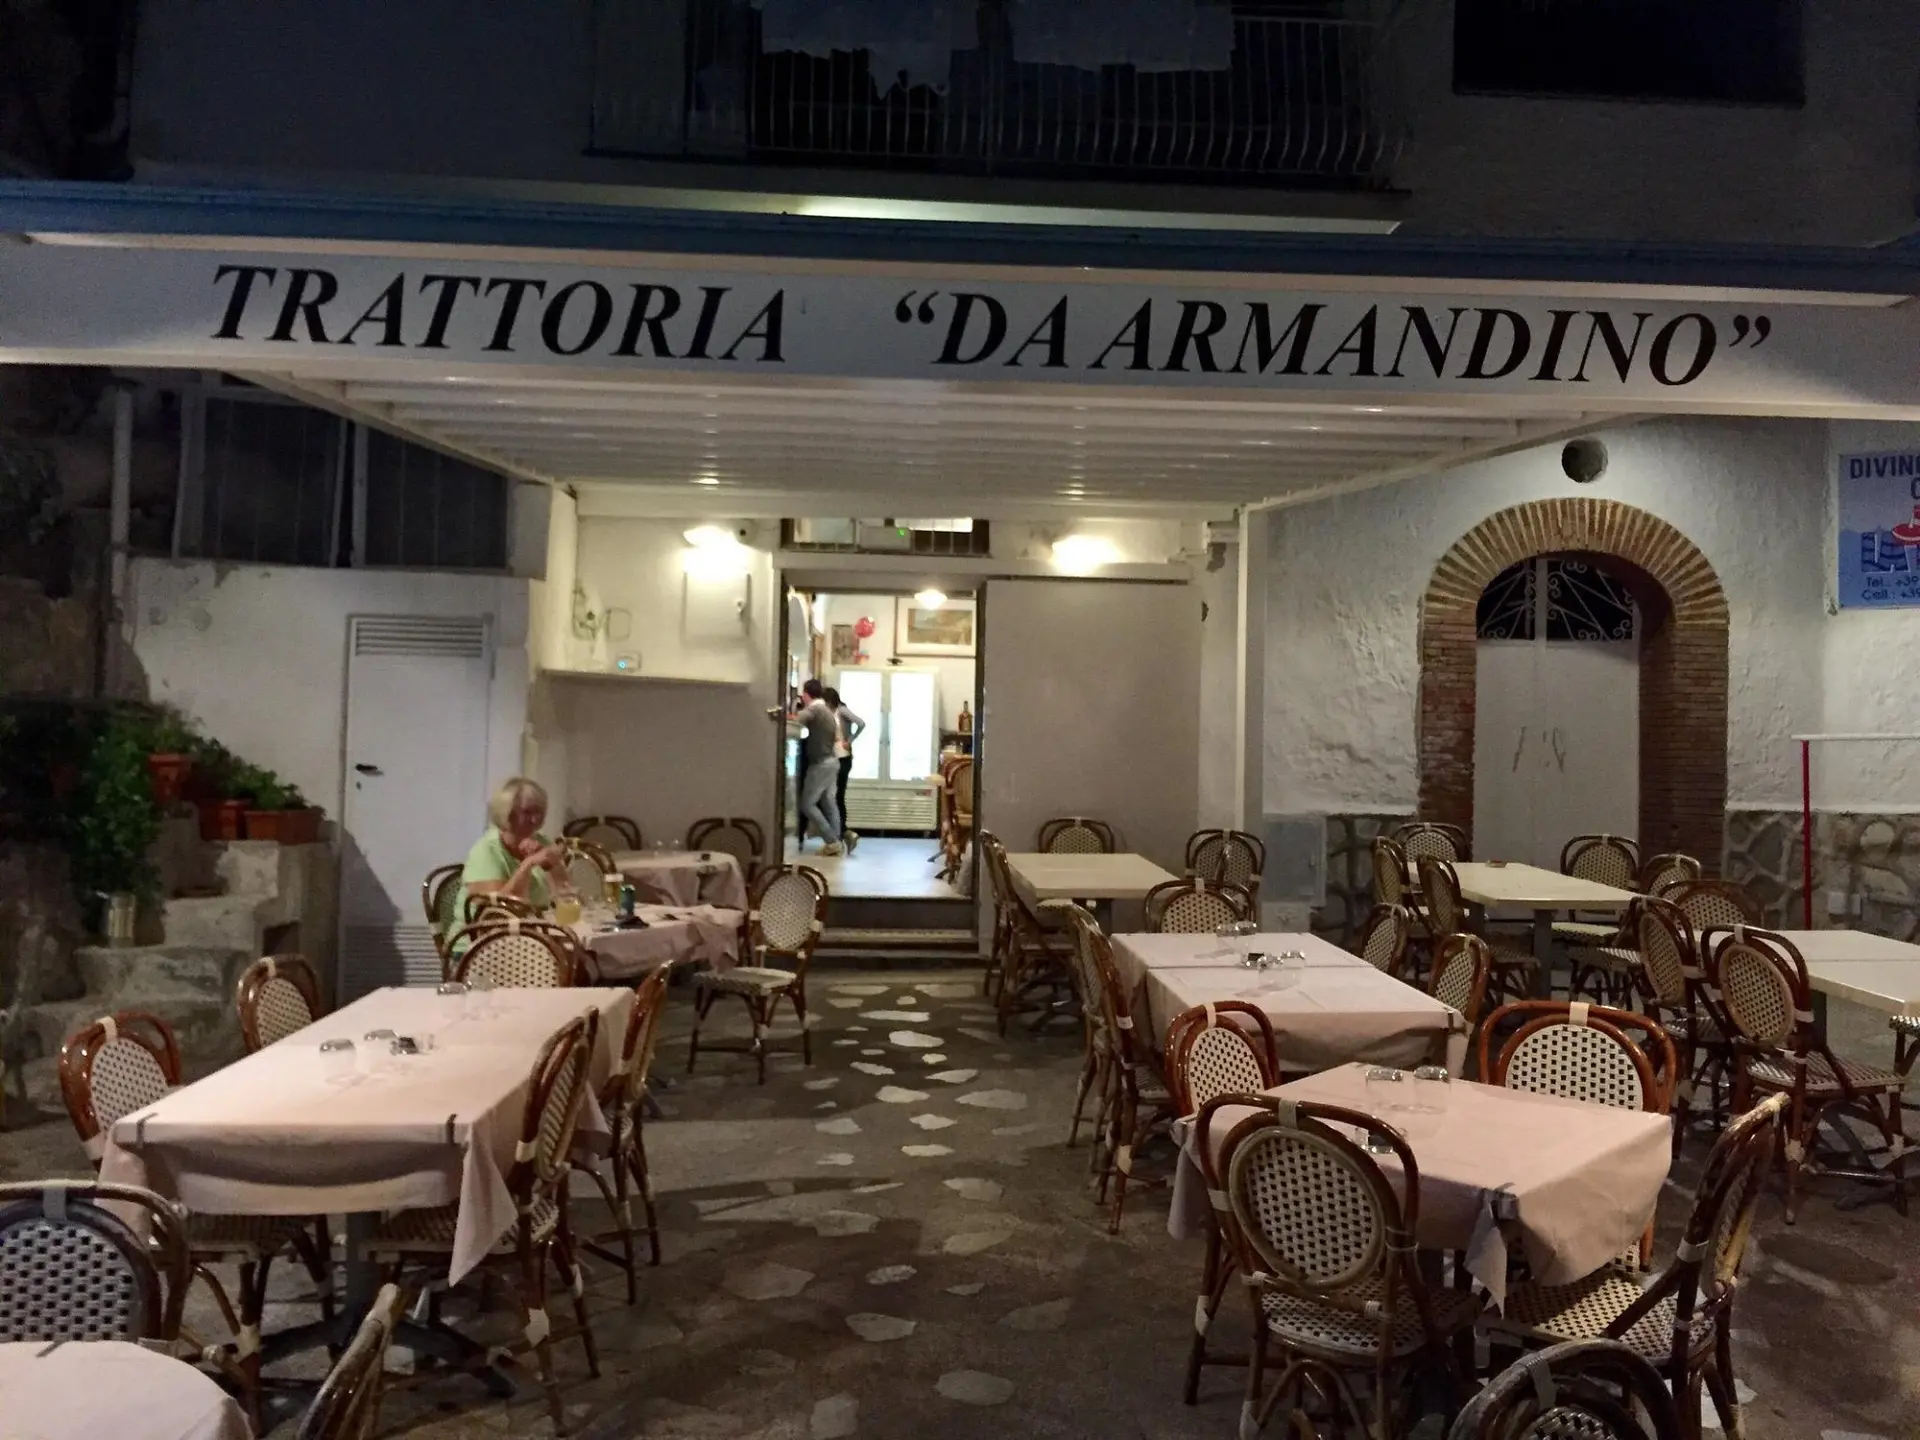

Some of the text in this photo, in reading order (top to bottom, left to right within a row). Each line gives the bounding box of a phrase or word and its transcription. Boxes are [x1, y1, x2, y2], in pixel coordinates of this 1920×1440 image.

[211, 263, 1773, 387] TRATTORIA “DA ARMANDINO”
